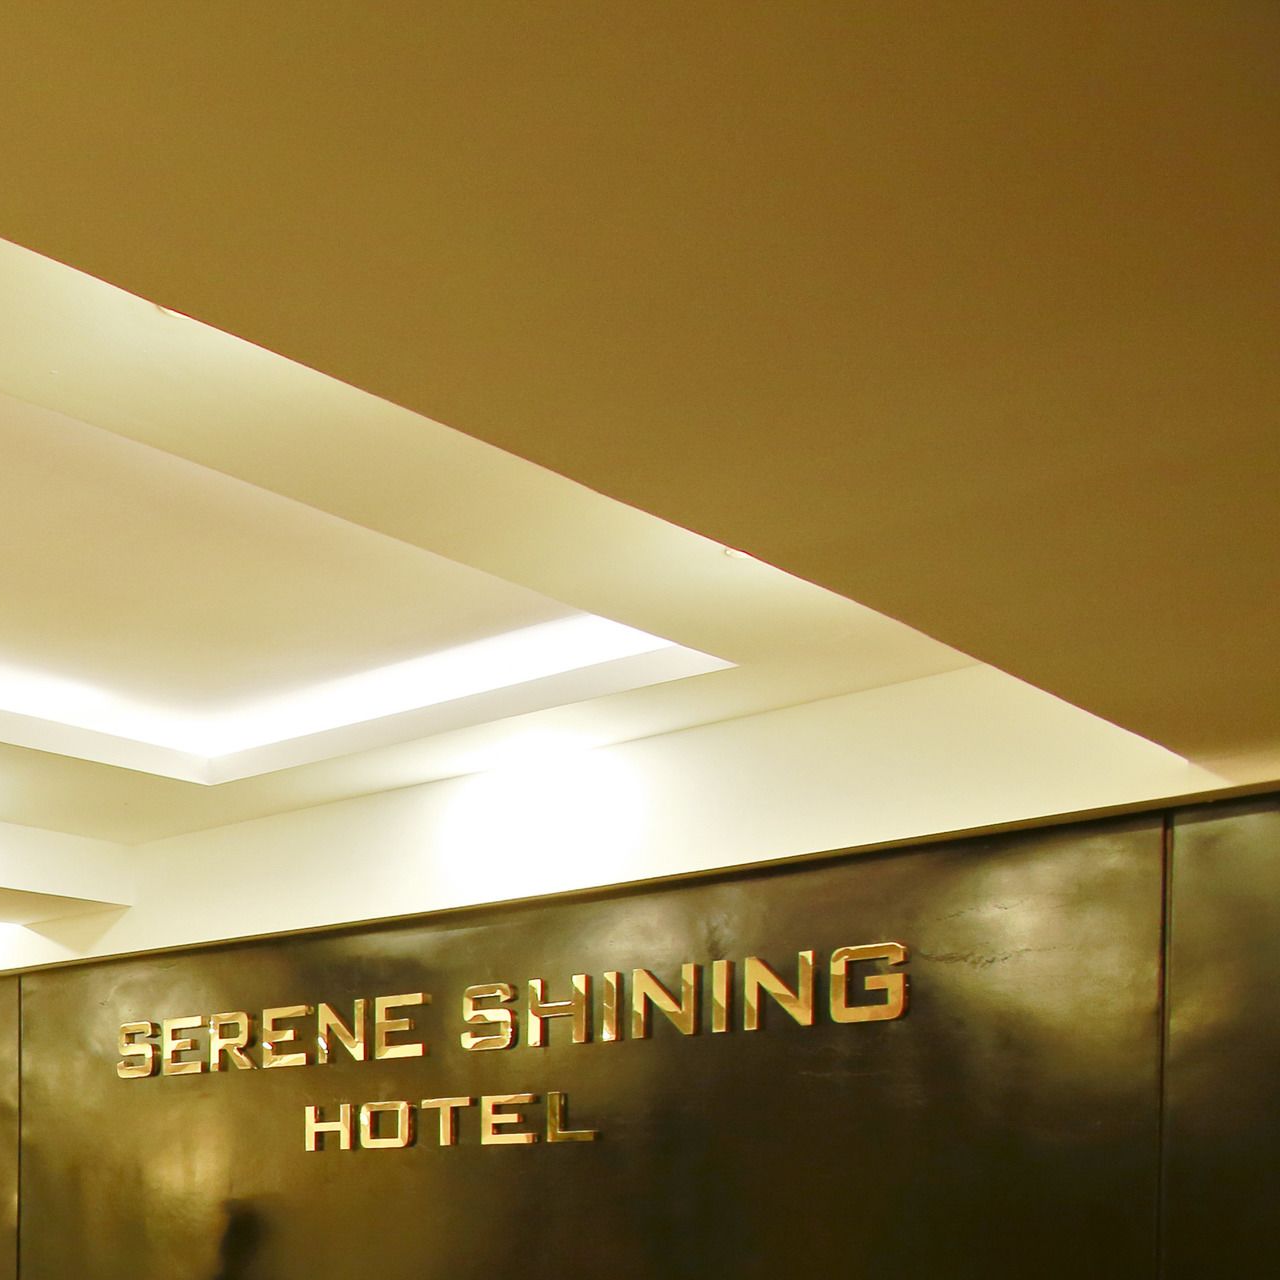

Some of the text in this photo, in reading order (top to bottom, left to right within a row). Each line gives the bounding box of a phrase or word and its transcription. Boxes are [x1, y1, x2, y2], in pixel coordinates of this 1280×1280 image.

[116, 942, 910, 1080] SERENE SHINING
[304, 1090, 600, 1153] HOTEL
